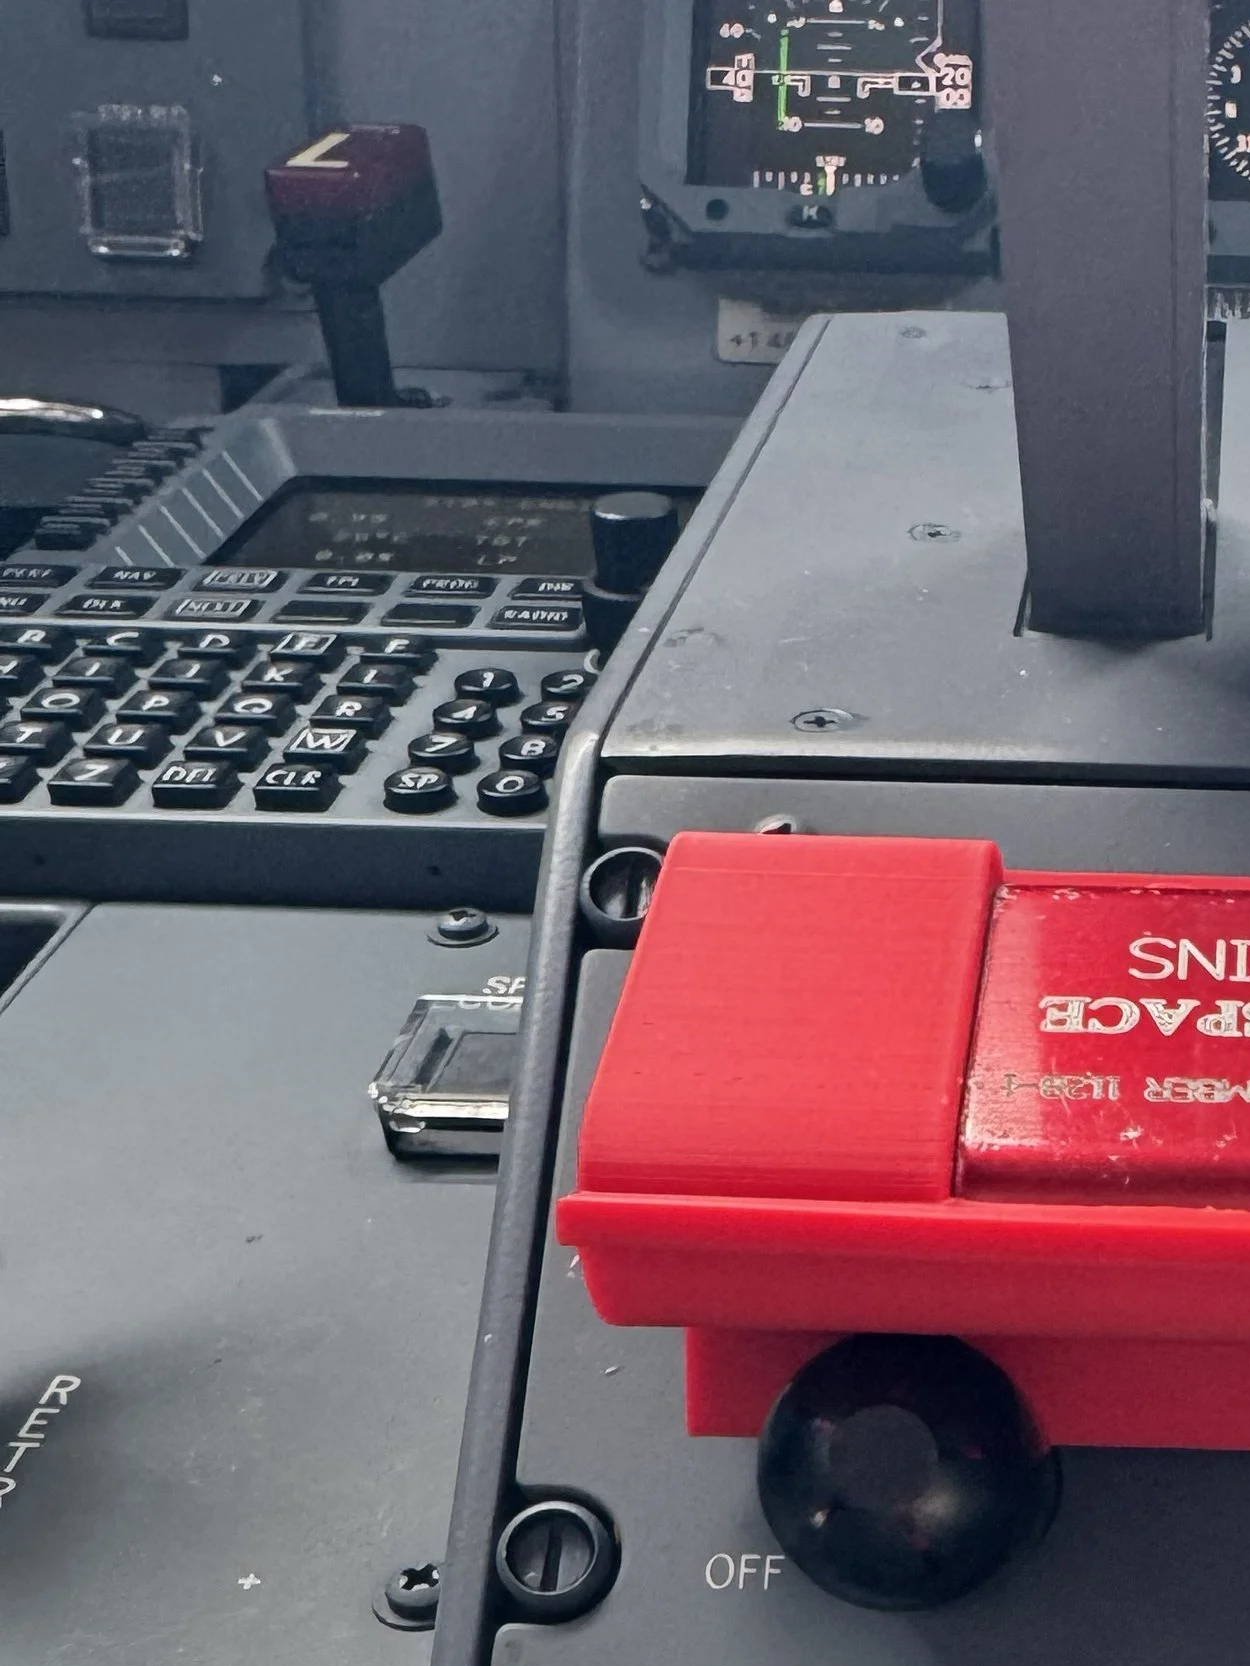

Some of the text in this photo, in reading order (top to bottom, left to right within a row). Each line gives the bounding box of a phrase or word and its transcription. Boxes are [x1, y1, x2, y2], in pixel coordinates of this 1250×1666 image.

[262, 668, 294, 682] K
[142, 694, 170, 712] P
[15, 726, 43, 743] T
[106, 728, 145, 745] U
[214, 730, 247, 748] V
[703, 1552, 786, 1592] OFF
